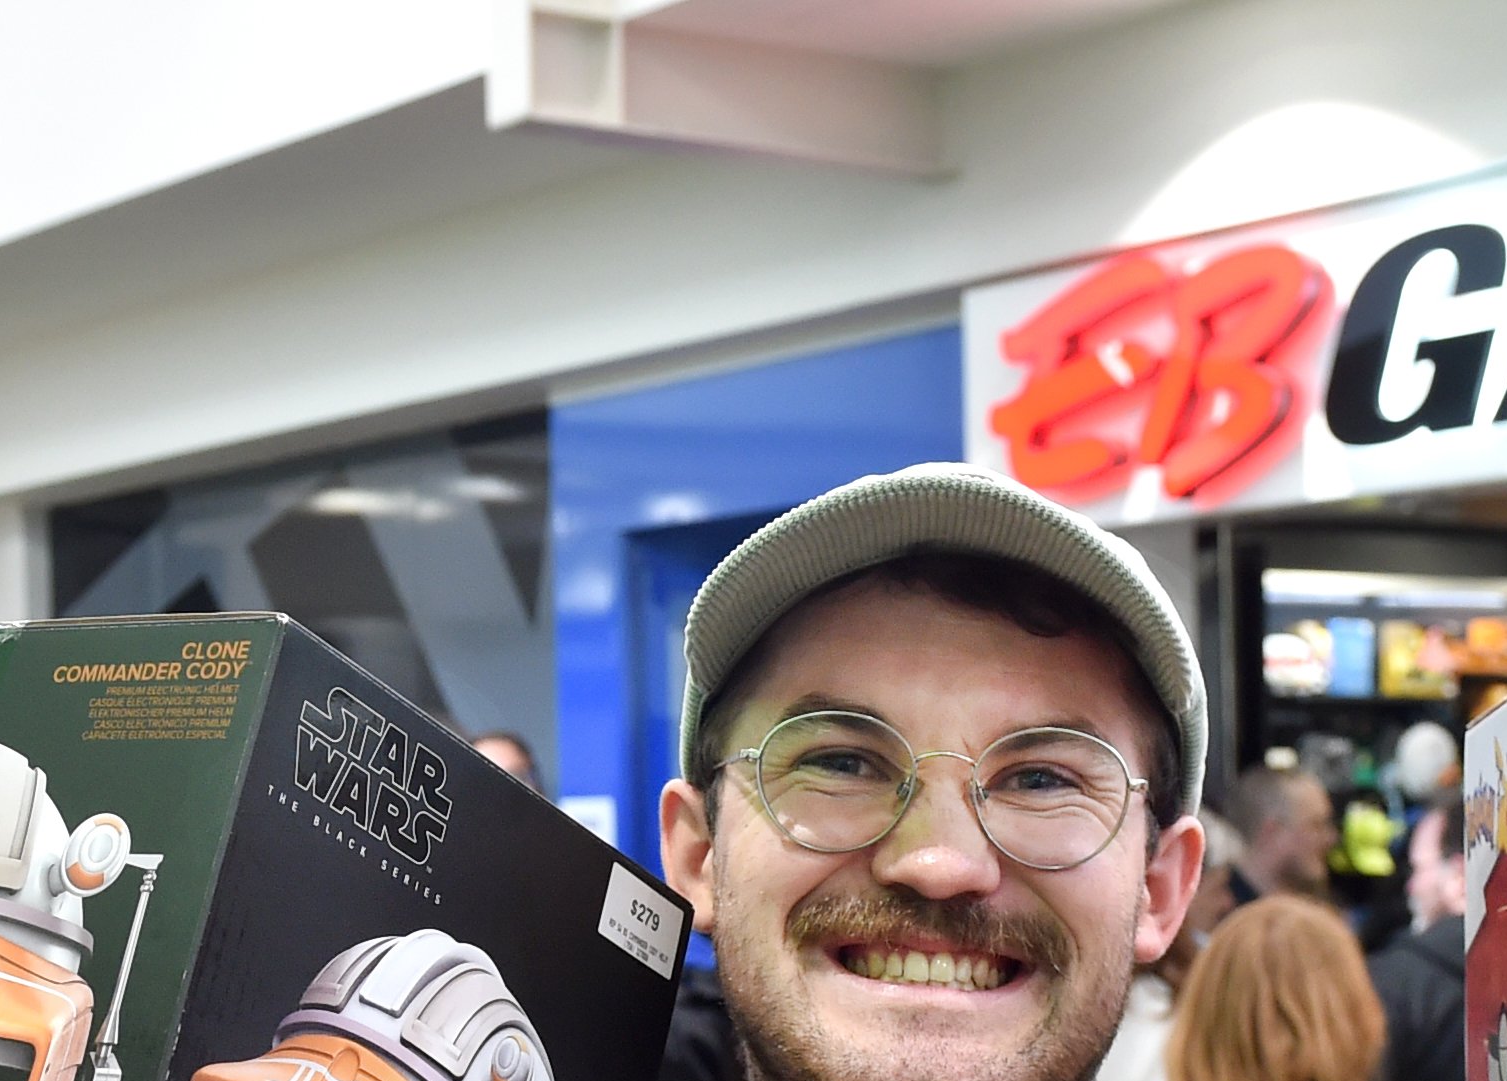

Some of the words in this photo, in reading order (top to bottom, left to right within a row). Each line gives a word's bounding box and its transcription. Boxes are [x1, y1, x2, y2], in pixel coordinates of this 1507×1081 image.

[986, 245, 1332, 505] EB
[181, 640, 251, 660] CLONE
[53, 662, 181, 683] COMMANDER
[185, 661, 246, 680] CODY
[106, 686, 145, 696] PREMIUM
[147, 685, 202, 696] ELECTRONIC
[205, 683, 240, 694] HELMET
[88, 698, 125, 708] CASQUE
[195, 696, 237, 705] PREMIUM
[88, 707, 165, 718] ELEKTRONISCHER
[166, 707, 208, 717] PREMIUM
[208, 706, 234, 716] HELM
[94, 719, 125, 729] CASCO
[189, 718, 231, 727] PREMIUM
[81, 730, 128, 741] CAPACETE
[185, 730, 227, 740] ESPECIAL
[300, 686, 453, 821] STAR
[295, 725, 447, 866] WARS
[267, 784, 300, 813] THE
[312, 814, 367, 858] BLACK
[380, 859, 441, 905] SERIES
[630, 899, 661, 932] $279
